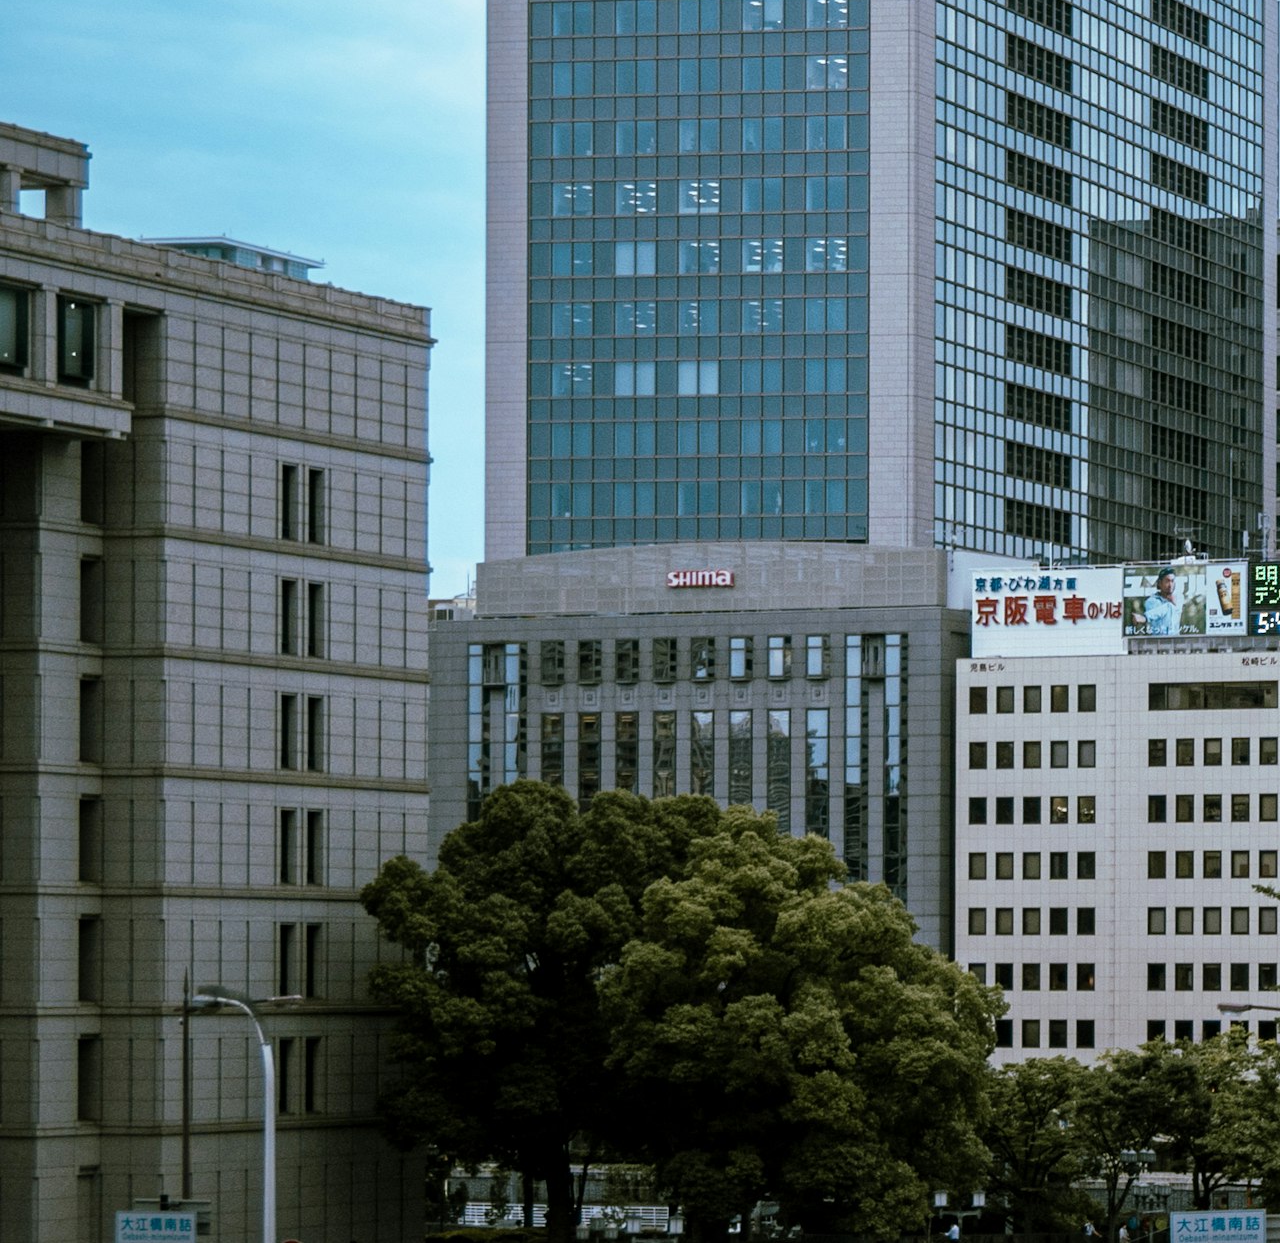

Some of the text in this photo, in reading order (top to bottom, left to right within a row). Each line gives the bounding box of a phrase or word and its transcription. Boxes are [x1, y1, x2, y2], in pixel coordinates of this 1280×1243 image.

[975, 576, 1077, 592] 京都・びわ湖方面
[975, 594, 1122, 626] 京阪電車のりば
[121, 1217, 191, 1231] 大江橋南詰
[1177, 1217, 1260, 1232] 大江橋南詰
